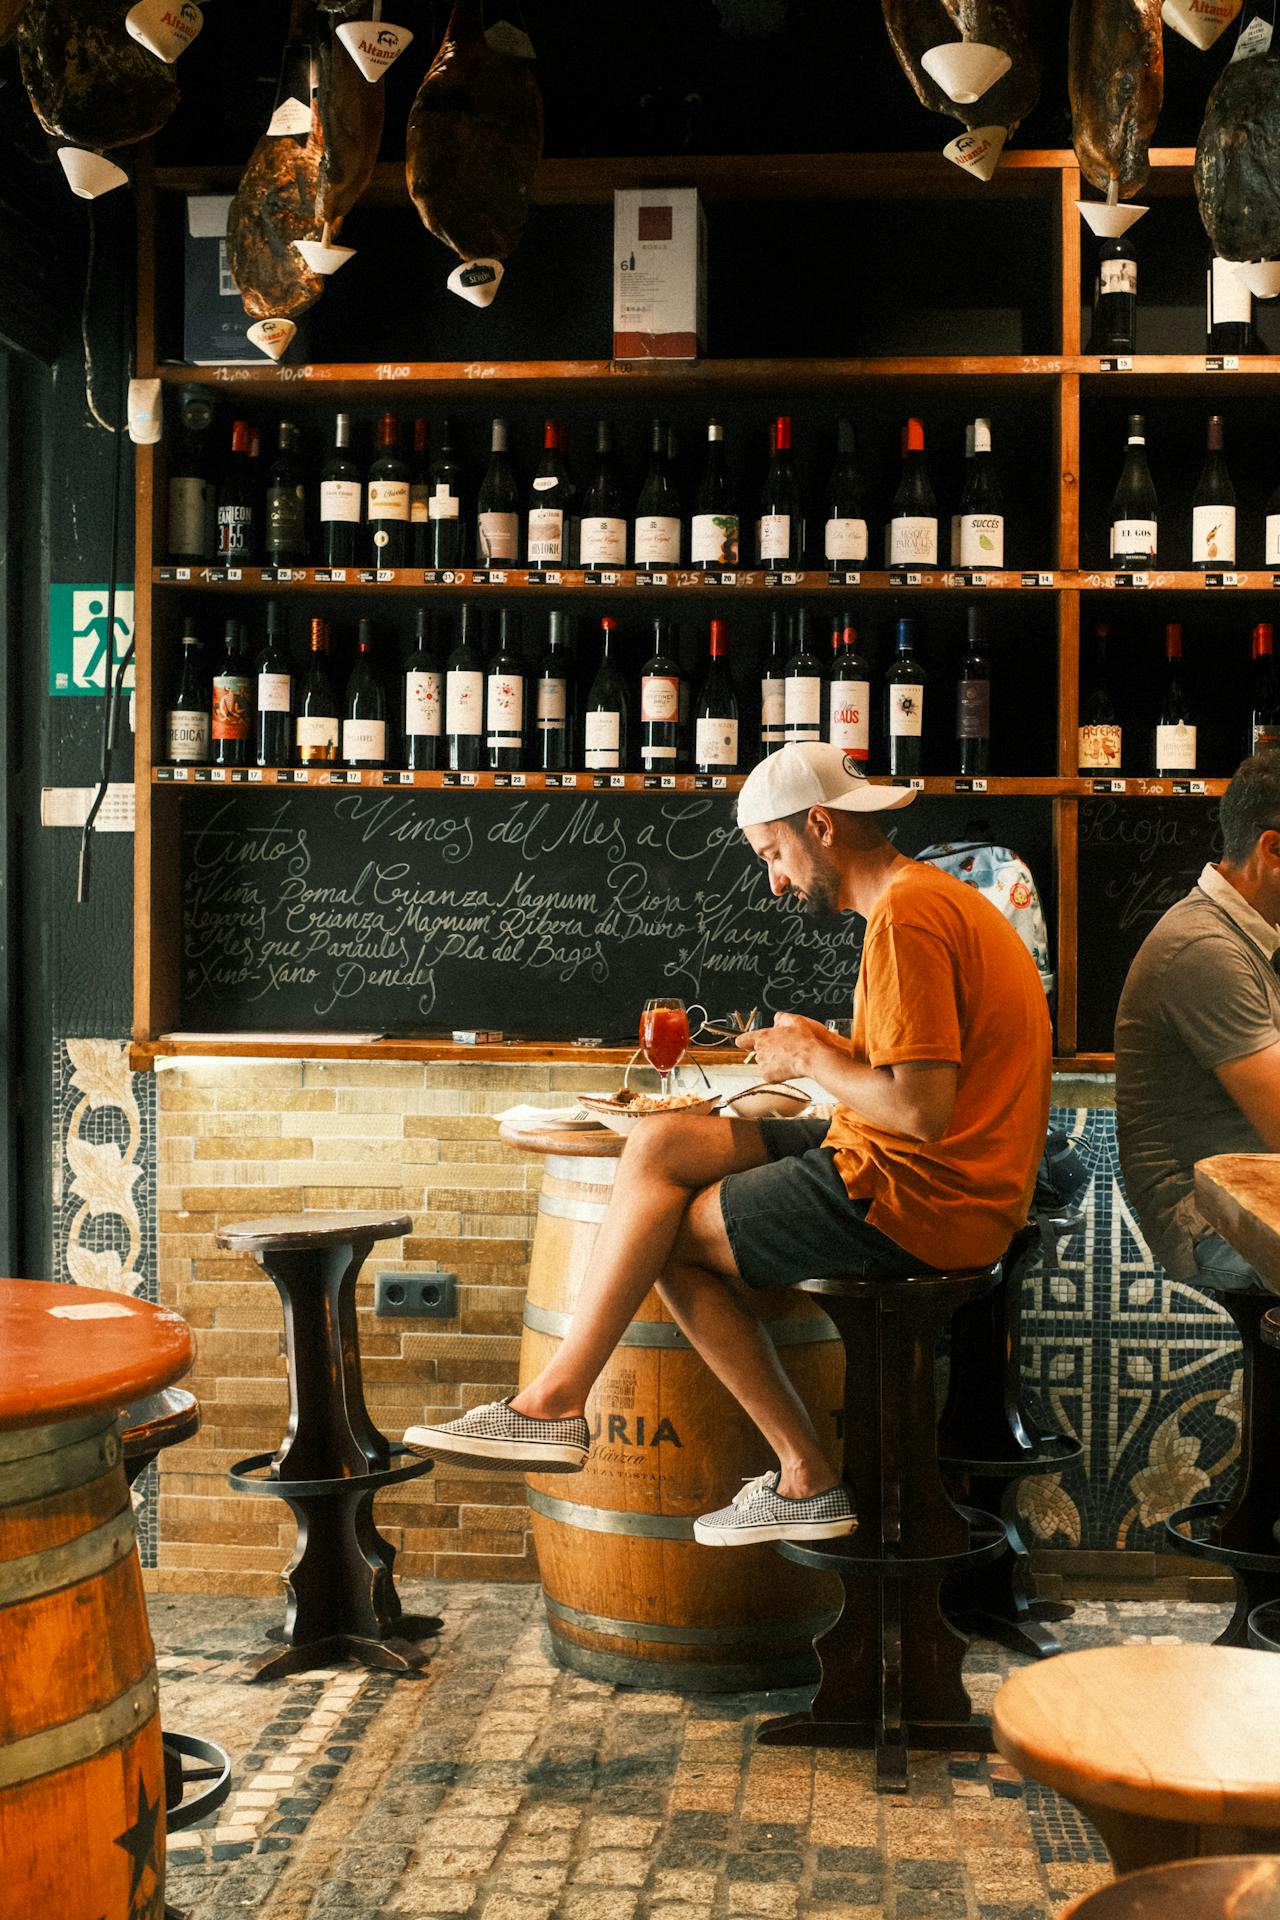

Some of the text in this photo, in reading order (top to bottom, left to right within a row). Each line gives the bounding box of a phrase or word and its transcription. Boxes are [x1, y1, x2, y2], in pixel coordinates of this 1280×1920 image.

[621, 260, 629, 271] 6
[168, 729, 205, 743] REDICAT
[334, 795, 474, 864] Vinos
[487, 800, 551, 861] del
[541, 798, 627, 864] Mes
[637, 824, 663, 848] a
[374, 863, 495, 915] Crianza
[496, 871, 598, 920] Magnum
[598, 862, 693, 924] Rioja
[286, 904, 397, 943] Crianza
[491, 907, 594, 941] Ribera
[594, 909, 622, 938] del
[617, 912, 696, 945] Duero
[697, 904, 863, 956] Vaya Pasada
[257, 940, 303, 969] que
[296, 929, 410, 969] Paraules
[425, 933, 489, 967] Pla
[491, 936, 526, 962] del
[519, 934, 610, 984] Bages
[775, 946, 800, 974] de
[797, 947, 861, 987] Rai
[763, 974, 856, 1012] Coster
